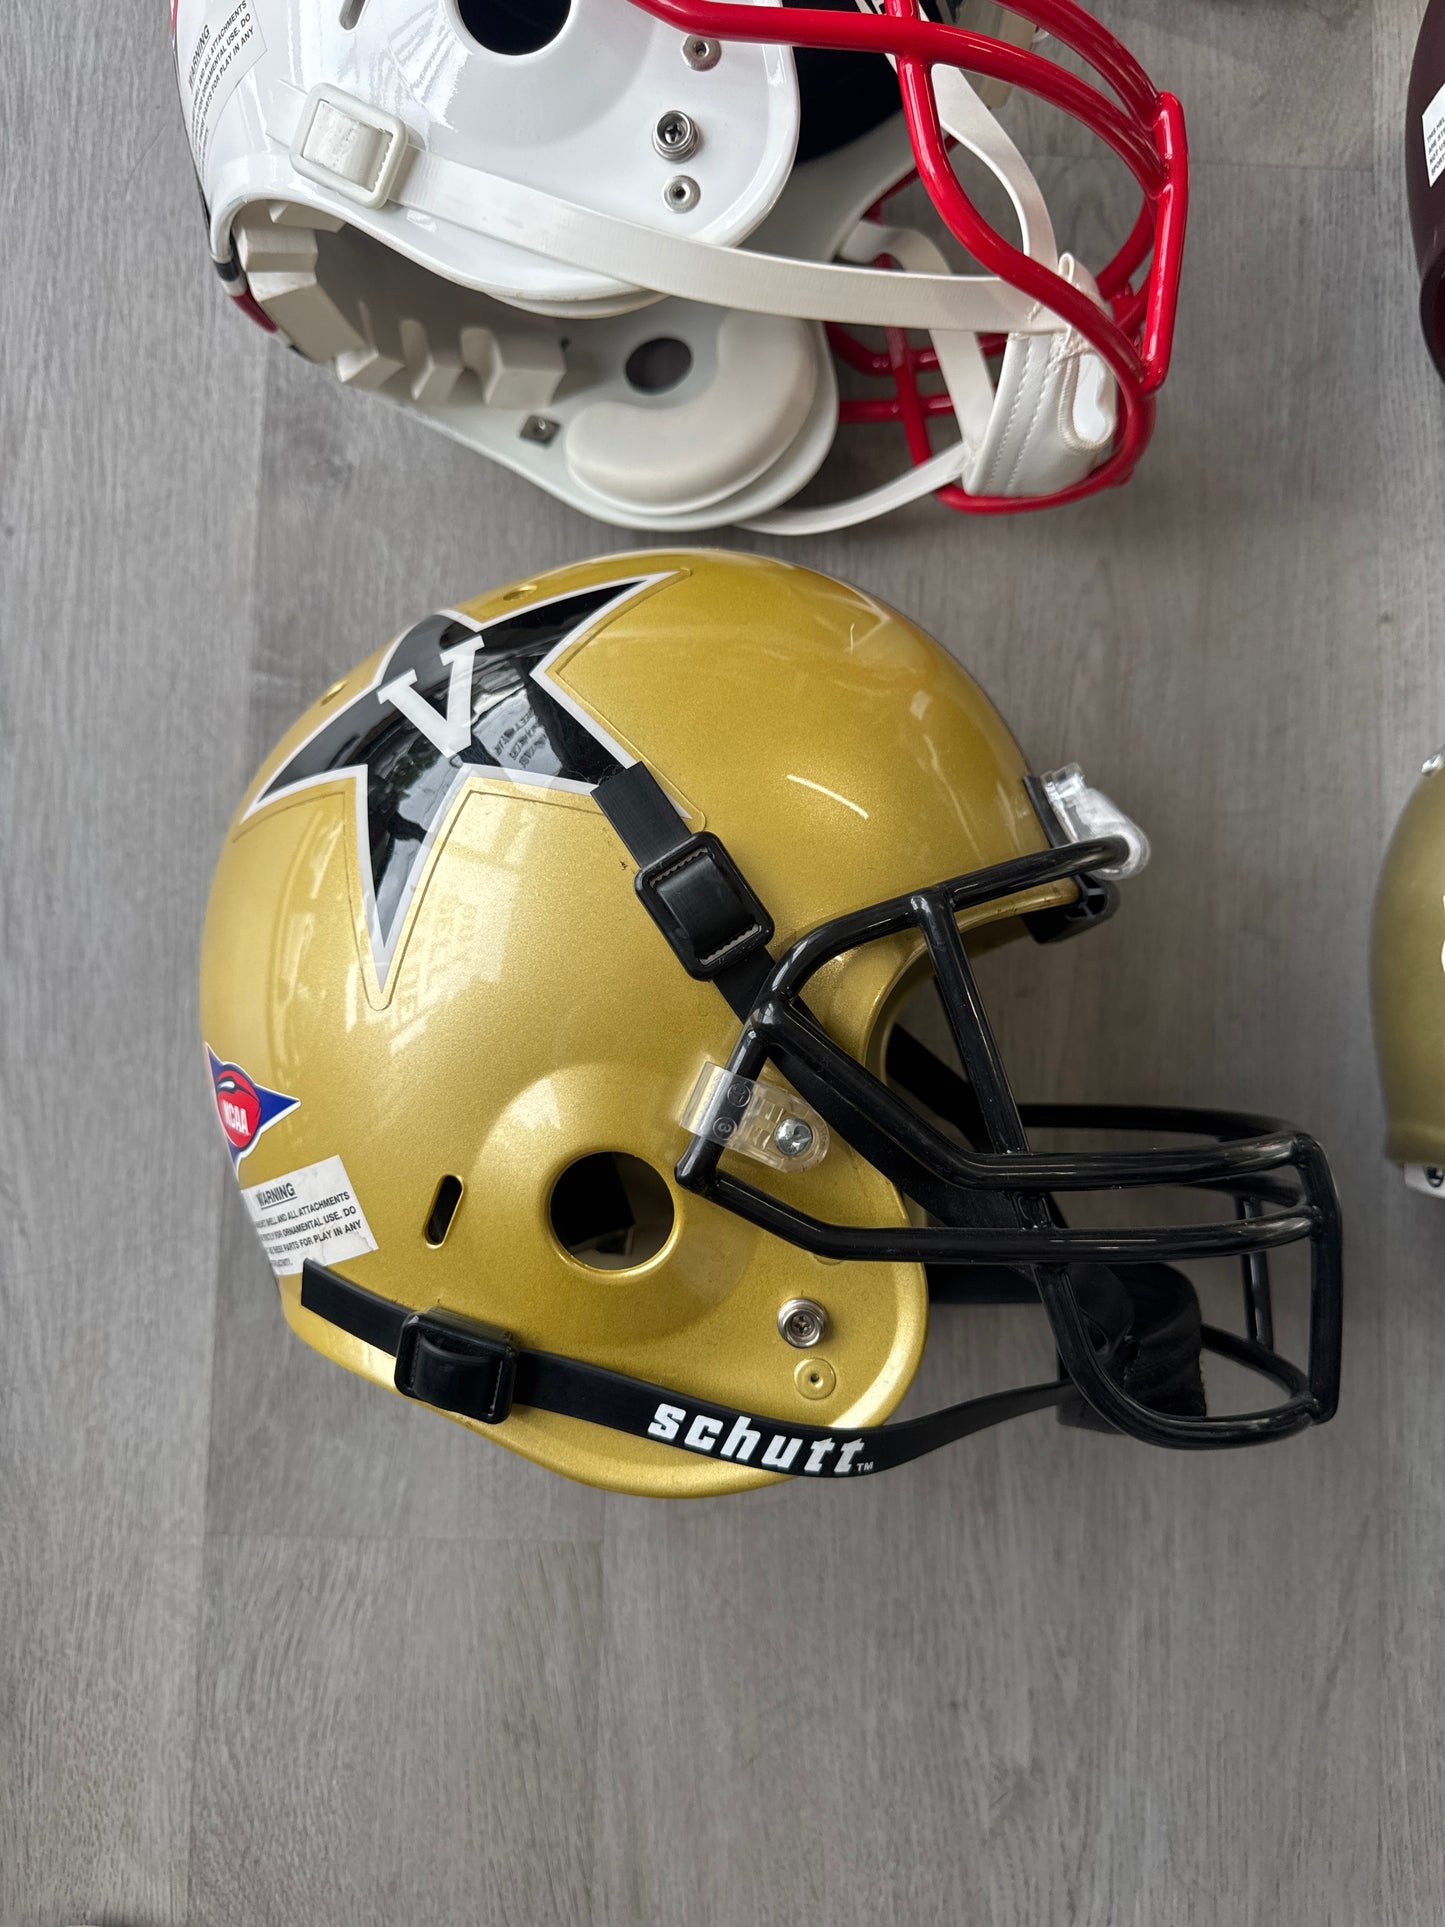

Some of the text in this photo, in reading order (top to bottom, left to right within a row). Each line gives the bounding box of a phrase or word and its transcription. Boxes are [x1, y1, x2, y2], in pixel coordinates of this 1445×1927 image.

[202, 45, 227, 97] ORNAMENTAL
[226, 27, 241, 46] USE.
[240, 13, 251, 28] DO
[211, 0, 247, 56] ATTACHMENTS
[188, 24, 210, 93] WARNING
[211, 74, 220, 94] FOR
[220, 52, 232, 76] PLAY
[232, 43, 240, 56] IN
[241, 25, 254, 46] ANY
[377, 633, 485, 758] V
[222, 1099, 249, 1136] NCAA
[256, 1182, 296, 1207] WARNING
[283, 1217, 323, 1237] ORNAMENTAL
[323, 1211, 342, 1224] USE.
[343, 1205, 357, 1217] DO
[288, 1209, 299, 1219] ALL
[298, 1191, 350, 1217] ATTACHMENTS
[284, 1241, 300, 1252] PARTS
[299, 1236, 313, 1247] FOR
[313, 1230, 332, 1243] PLAY
[333, 1226, 343, 1237] IN
[344, 1219, 362, 1233] ANY
[647, 1402, 865, 1474] schutt
